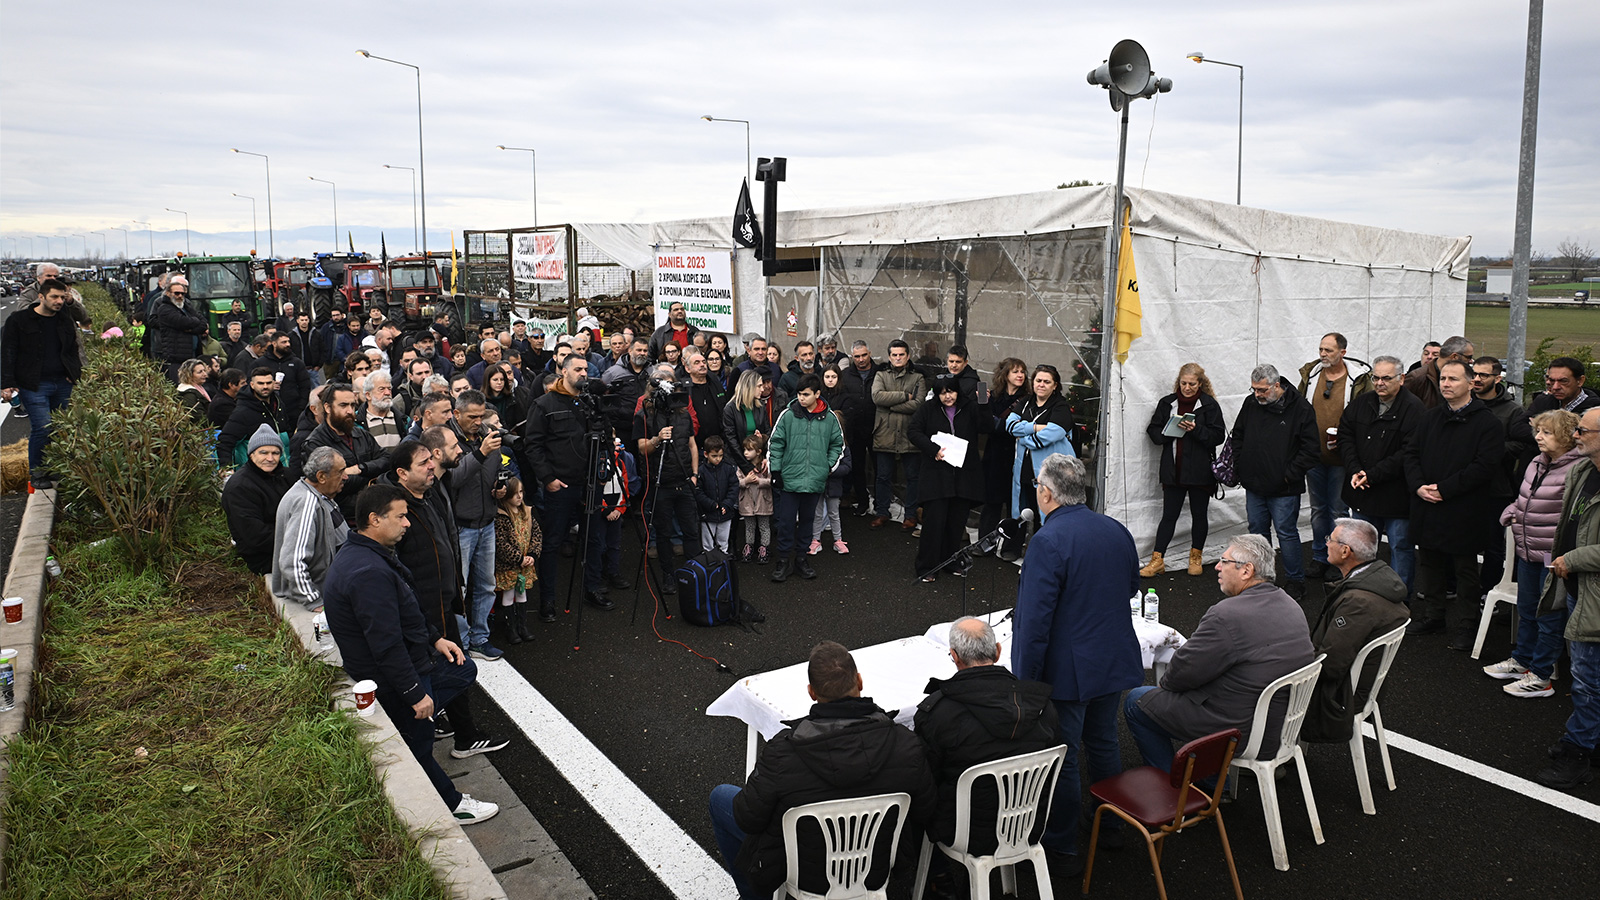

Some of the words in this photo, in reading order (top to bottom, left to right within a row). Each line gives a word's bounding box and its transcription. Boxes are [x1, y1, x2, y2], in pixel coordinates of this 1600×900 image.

[658, 256, 685, 268] DANIEL
[686, 256, 705, 268] 2023
[659, 273, 662, 282] 2
[663, 273, 682, 282] ΧΡΟΝΙΑ
[683, 273, 699, 283] ΧΩΡΙΣ
[700, 274, 712, 283] ΖΩΑ
[659, 287, 662, 295] 2
[663, 287, 682, 296] ΧΡΟΝΙΑ
[683, 288, 699, 297] ΧΩΡΙΣ
[701, 289, 731, 299] ΕΙΣΟΔΗΜΑ
[690, 303, 731, 314] ΔΙΑΧΩΡΙΣΜΟΣ
